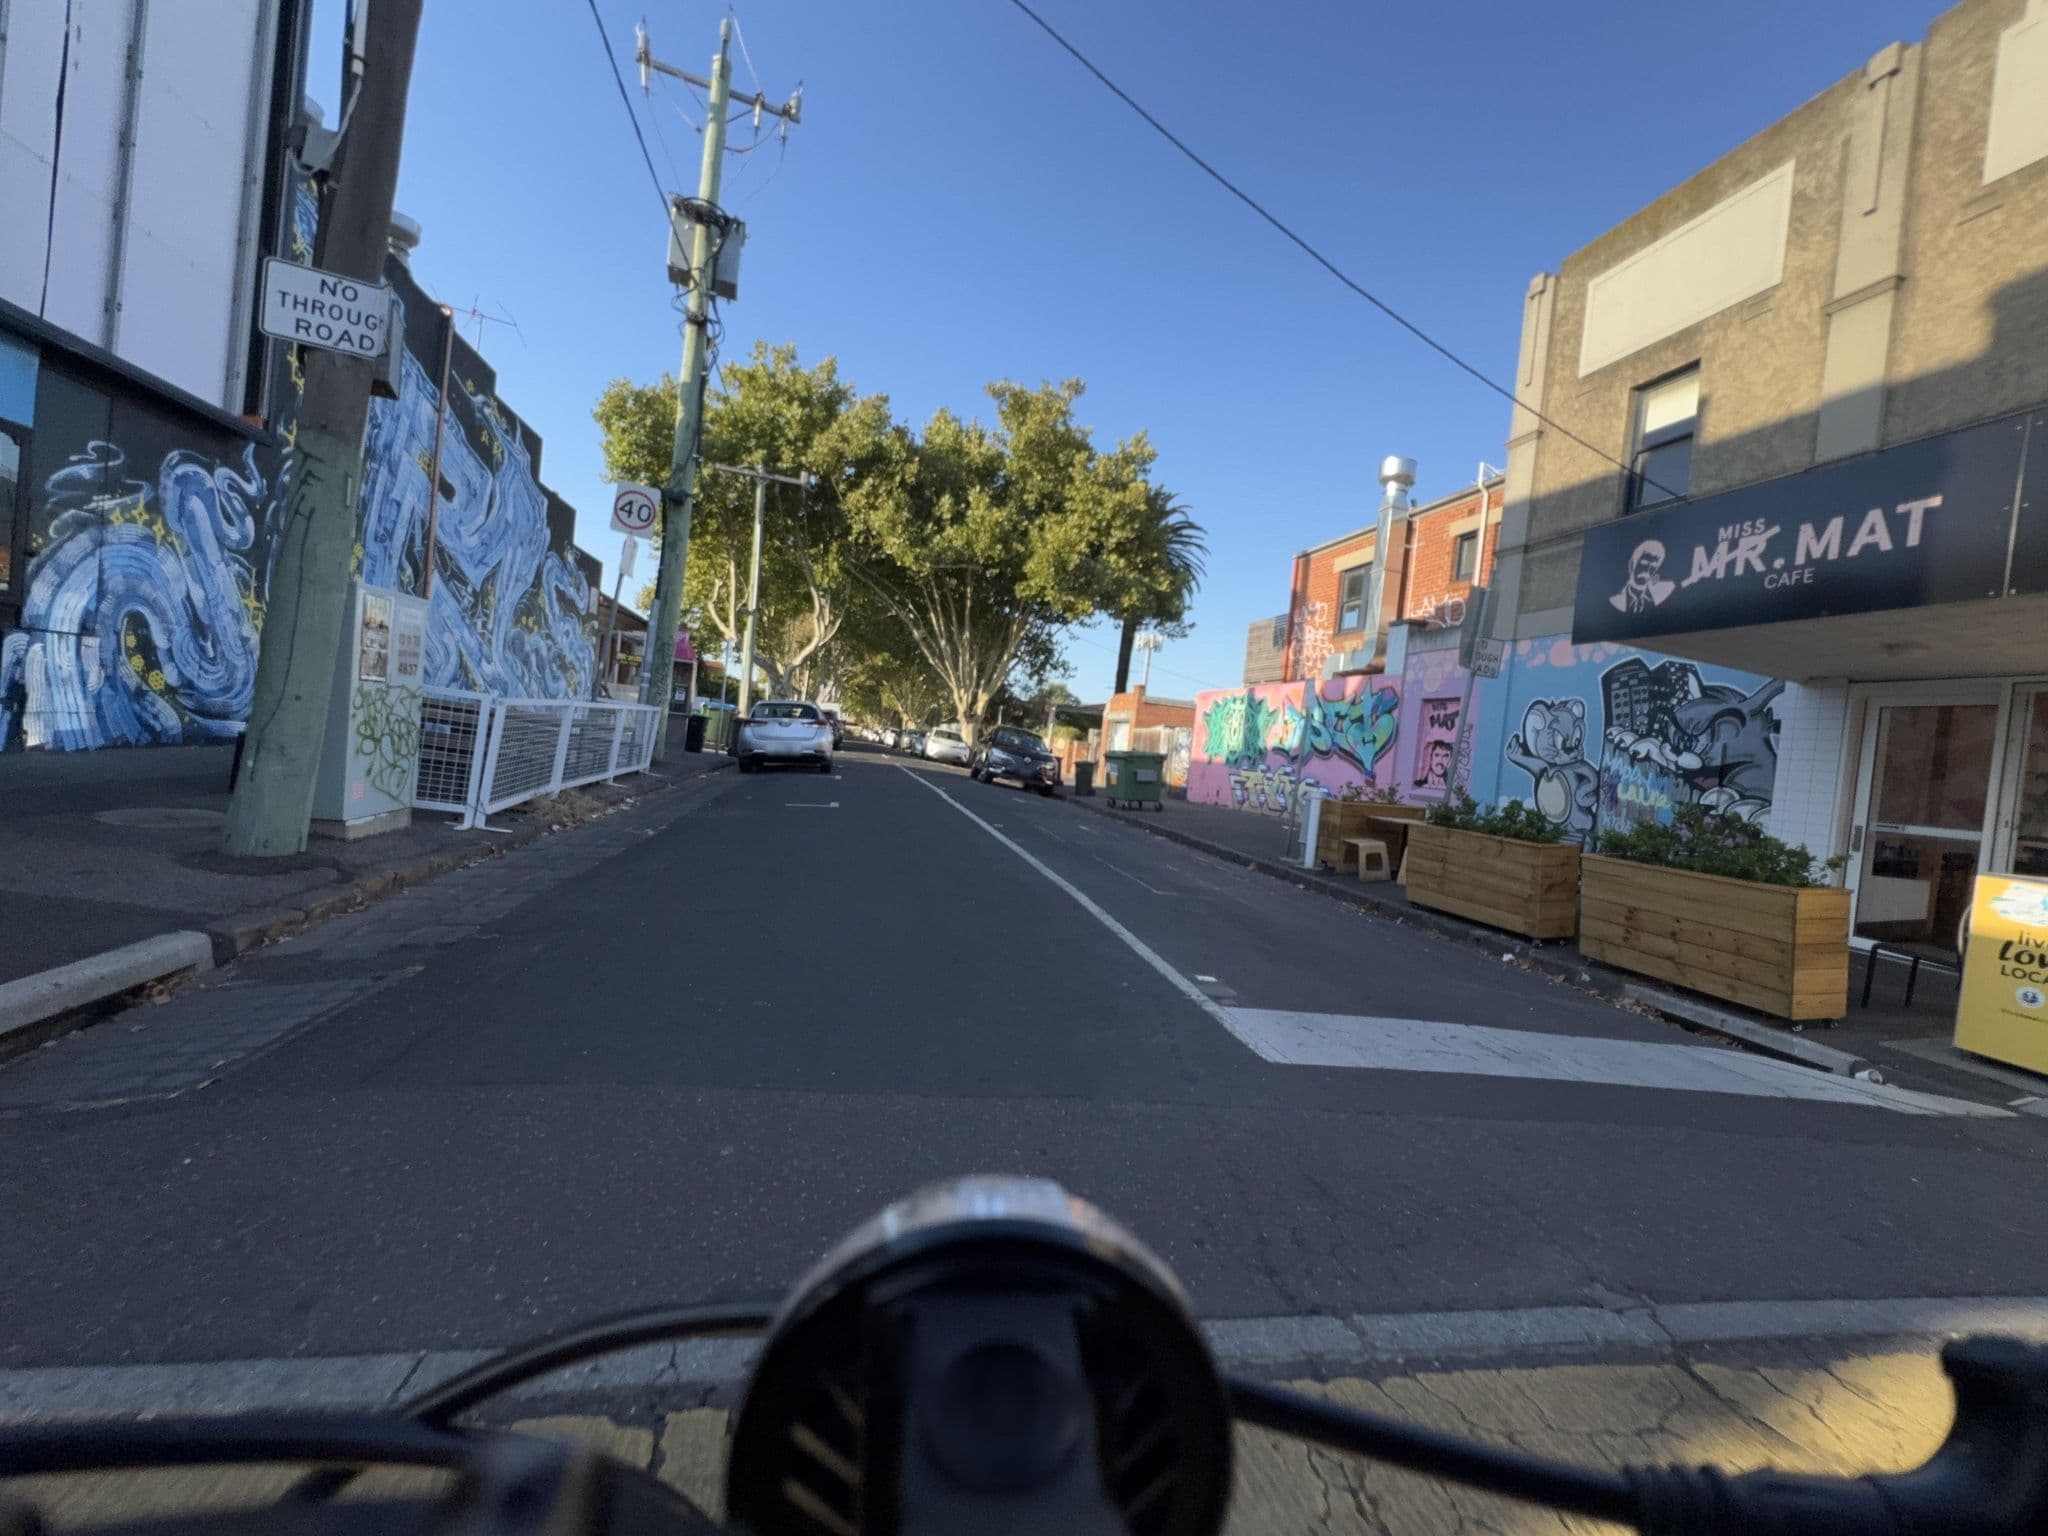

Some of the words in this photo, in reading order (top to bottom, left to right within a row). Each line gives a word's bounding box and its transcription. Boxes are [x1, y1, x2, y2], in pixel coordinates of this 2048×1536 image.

[320, 279, 358, 302] NO
[278, 290, 384, 331] THROUG
[294, 317, 375, 351] ROAD
[619, 500, 652, 522] 40
[1718, 518, 1766, 542] MISS
[1795, 496, 1943, 566] MAT
[1764, 568, 1816, 589] CAFE
